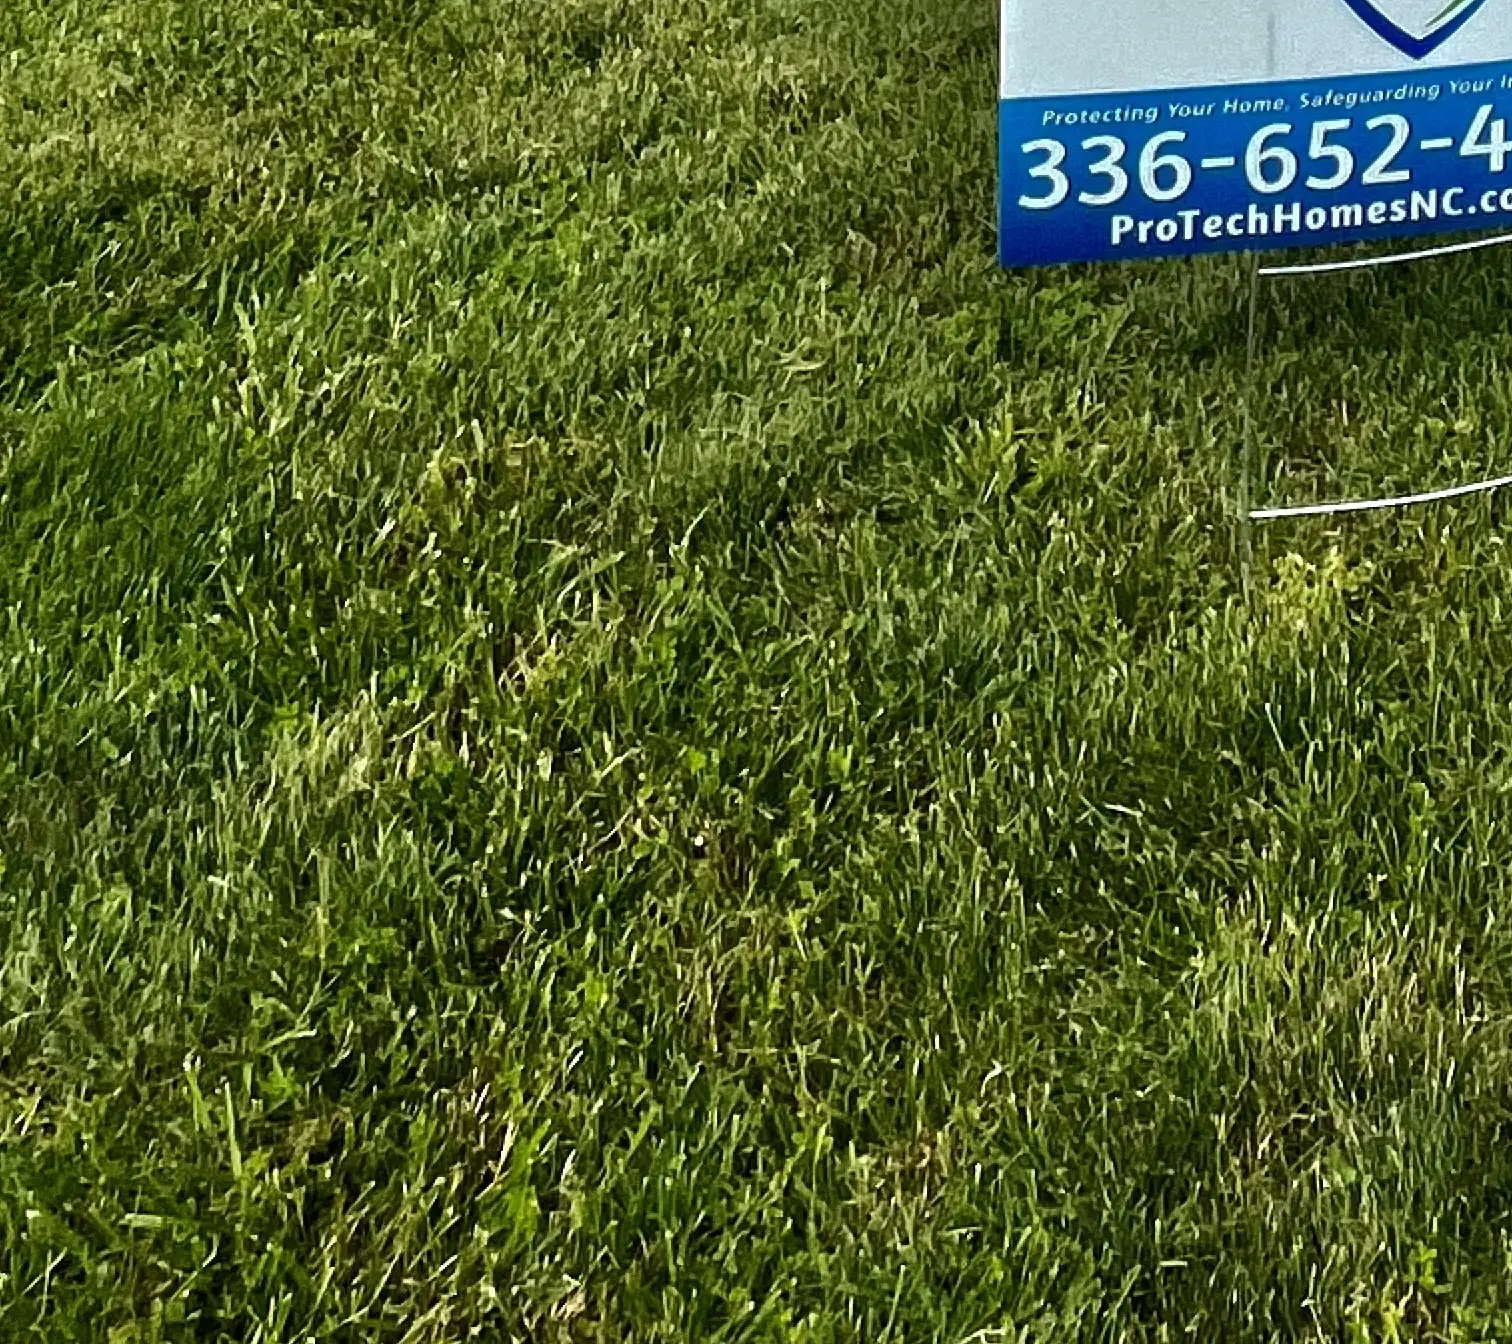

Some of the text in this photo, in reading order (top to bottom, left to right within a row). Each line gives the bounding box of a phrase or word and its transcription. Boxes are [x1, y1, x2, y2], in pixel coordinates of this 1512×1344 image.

[1042, 103, 1158, 126] Protecting
[1168, 101, 1215, 118] Your
[1300, 81, 1442, 109] Safeguarding
[1449, 77, 1494, 95] Your
